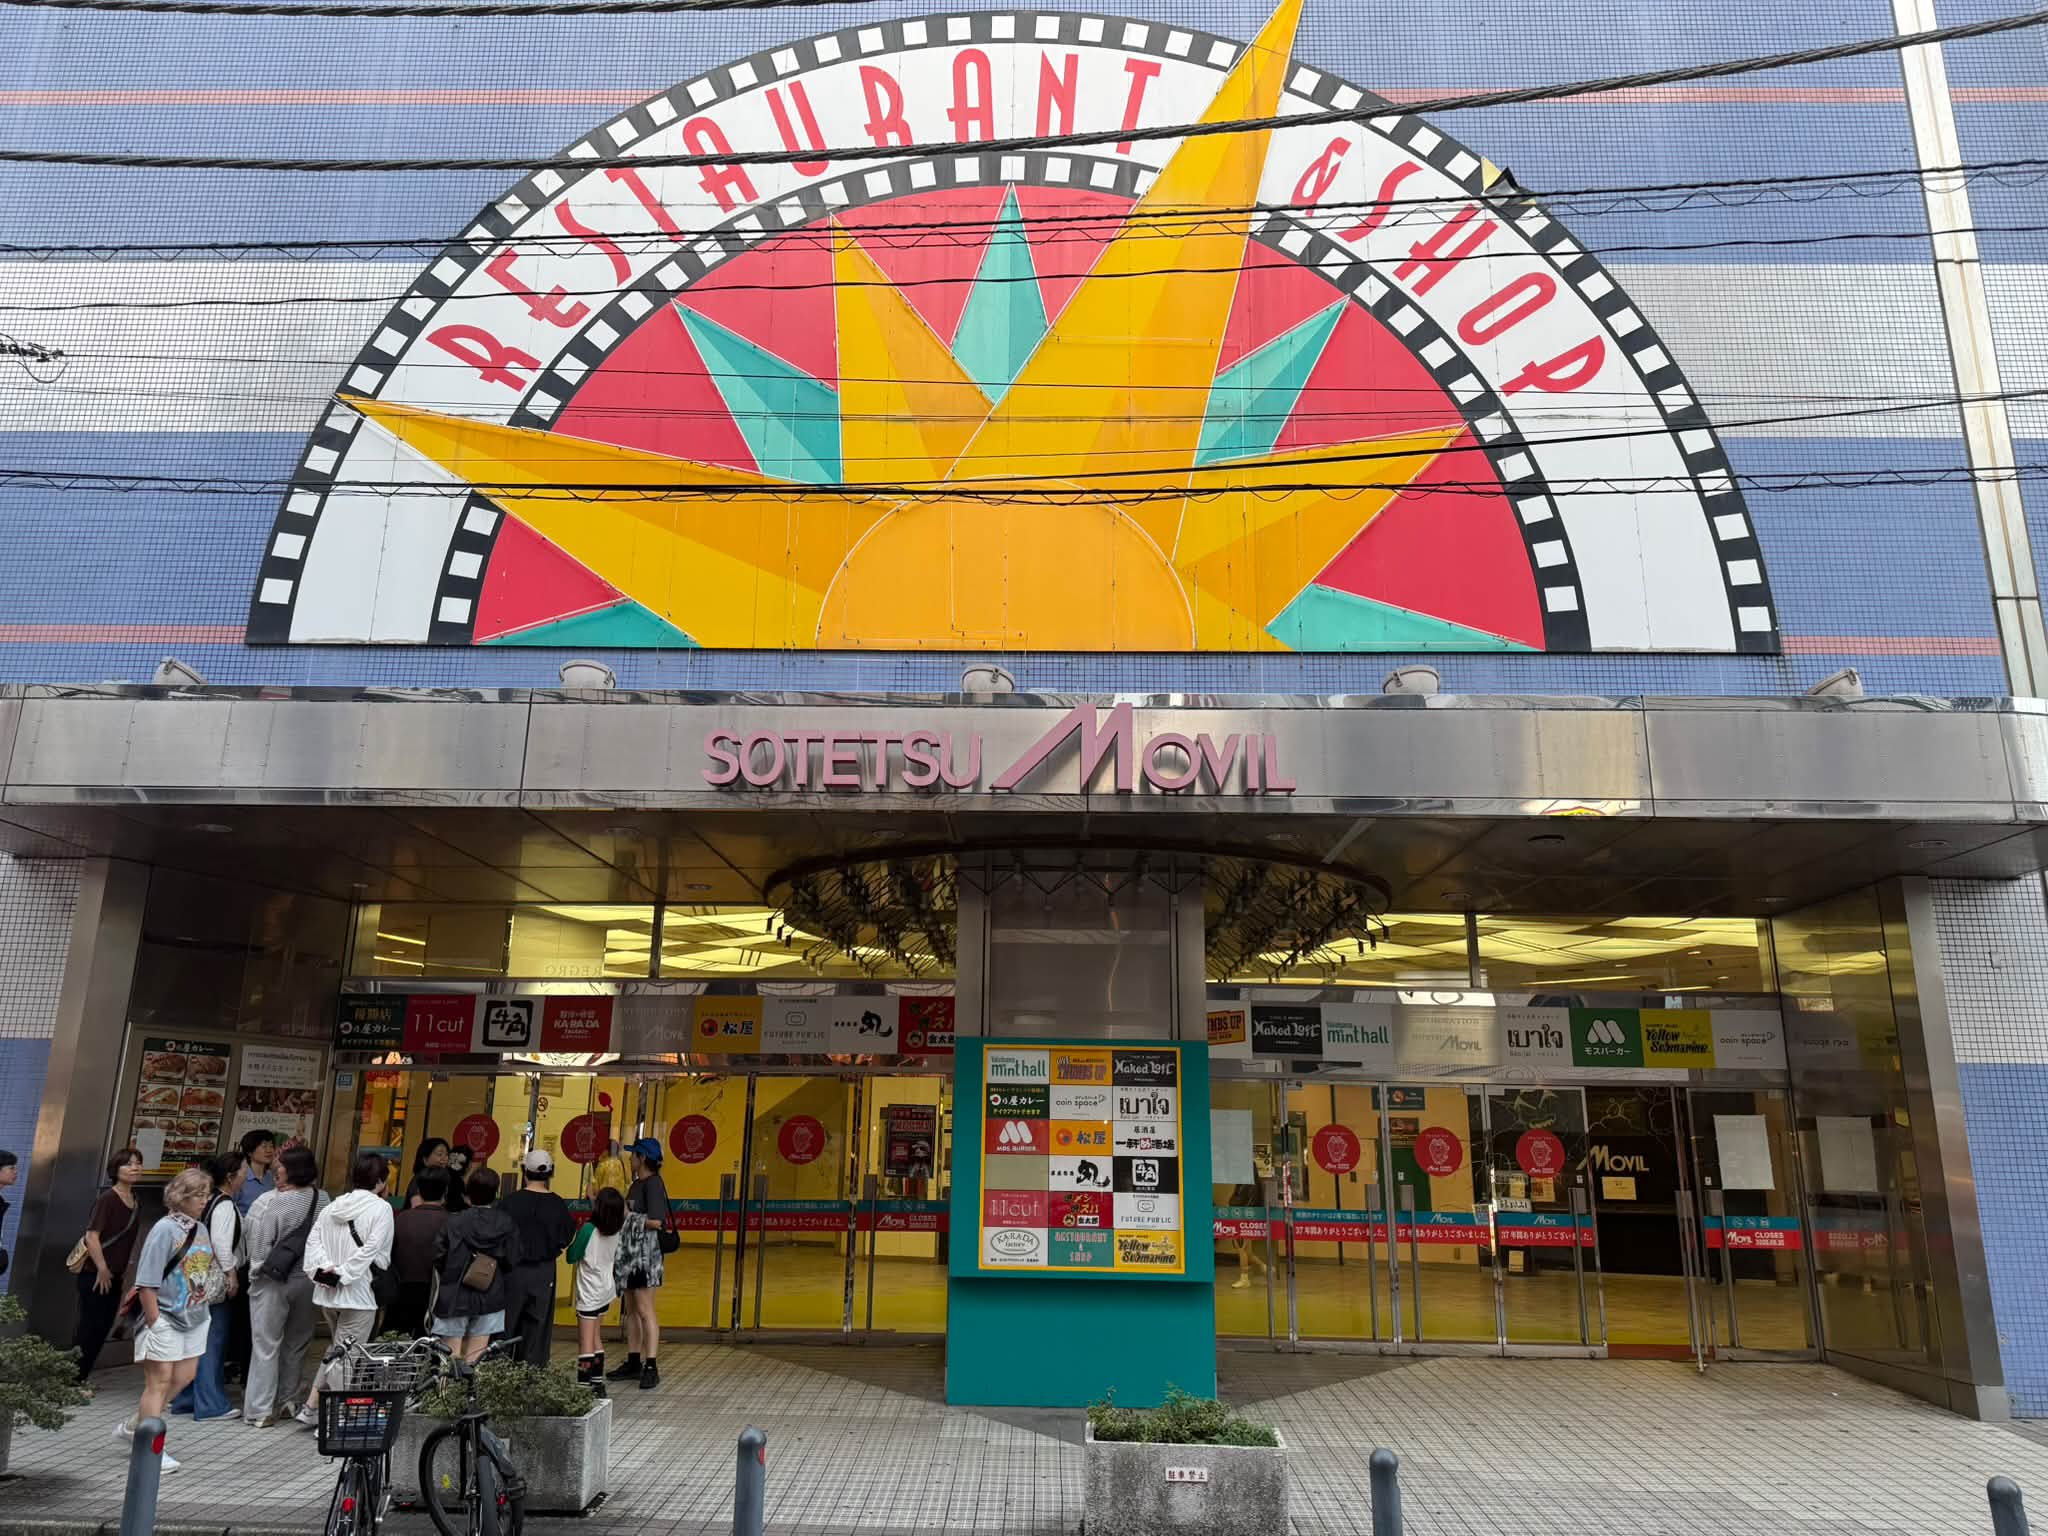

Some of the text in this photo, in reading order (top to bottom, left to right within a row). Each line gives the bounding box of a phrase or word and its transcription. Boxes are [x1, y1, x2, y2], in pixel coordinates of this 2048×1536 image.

[426, 48, 1161, 391] RESTAURANT
[1337, 161, 1606, 397] SHOP
[702, 702, 1297, 793] SOTETSU MOVIL
[490, 1008, 526, 1037] 牛角
[722, 1020, 754, 1035] 松屋
[1253, 1019, 1293, 1037] Naked
[1645, 1028, 1680, 1041] Yellow
[1584, 1047, 1632, 1056] モスバーガー
[1650, 1041, 1709, 1053] Submarine
[1114, 1058, 1149, 1074] Naked
[1056, 1097, 1098, 1109] coin space
[1076, 1130, 1106, 1145] 松屋
[1575, 1145, 1650, 1172] MOVIL
[1147, 1216, 1172, 1224] PUBLIC
[996, 1231, 1034, 1246] KARADA
[1754, 1231, 1785, 1239] CLOSES
[1118, 1239, 1152, 1252] Yellow
[1122, 1250, 1176, 1264] Submarine
[1168, 1470, 1206, 1480] 駐車禁止
